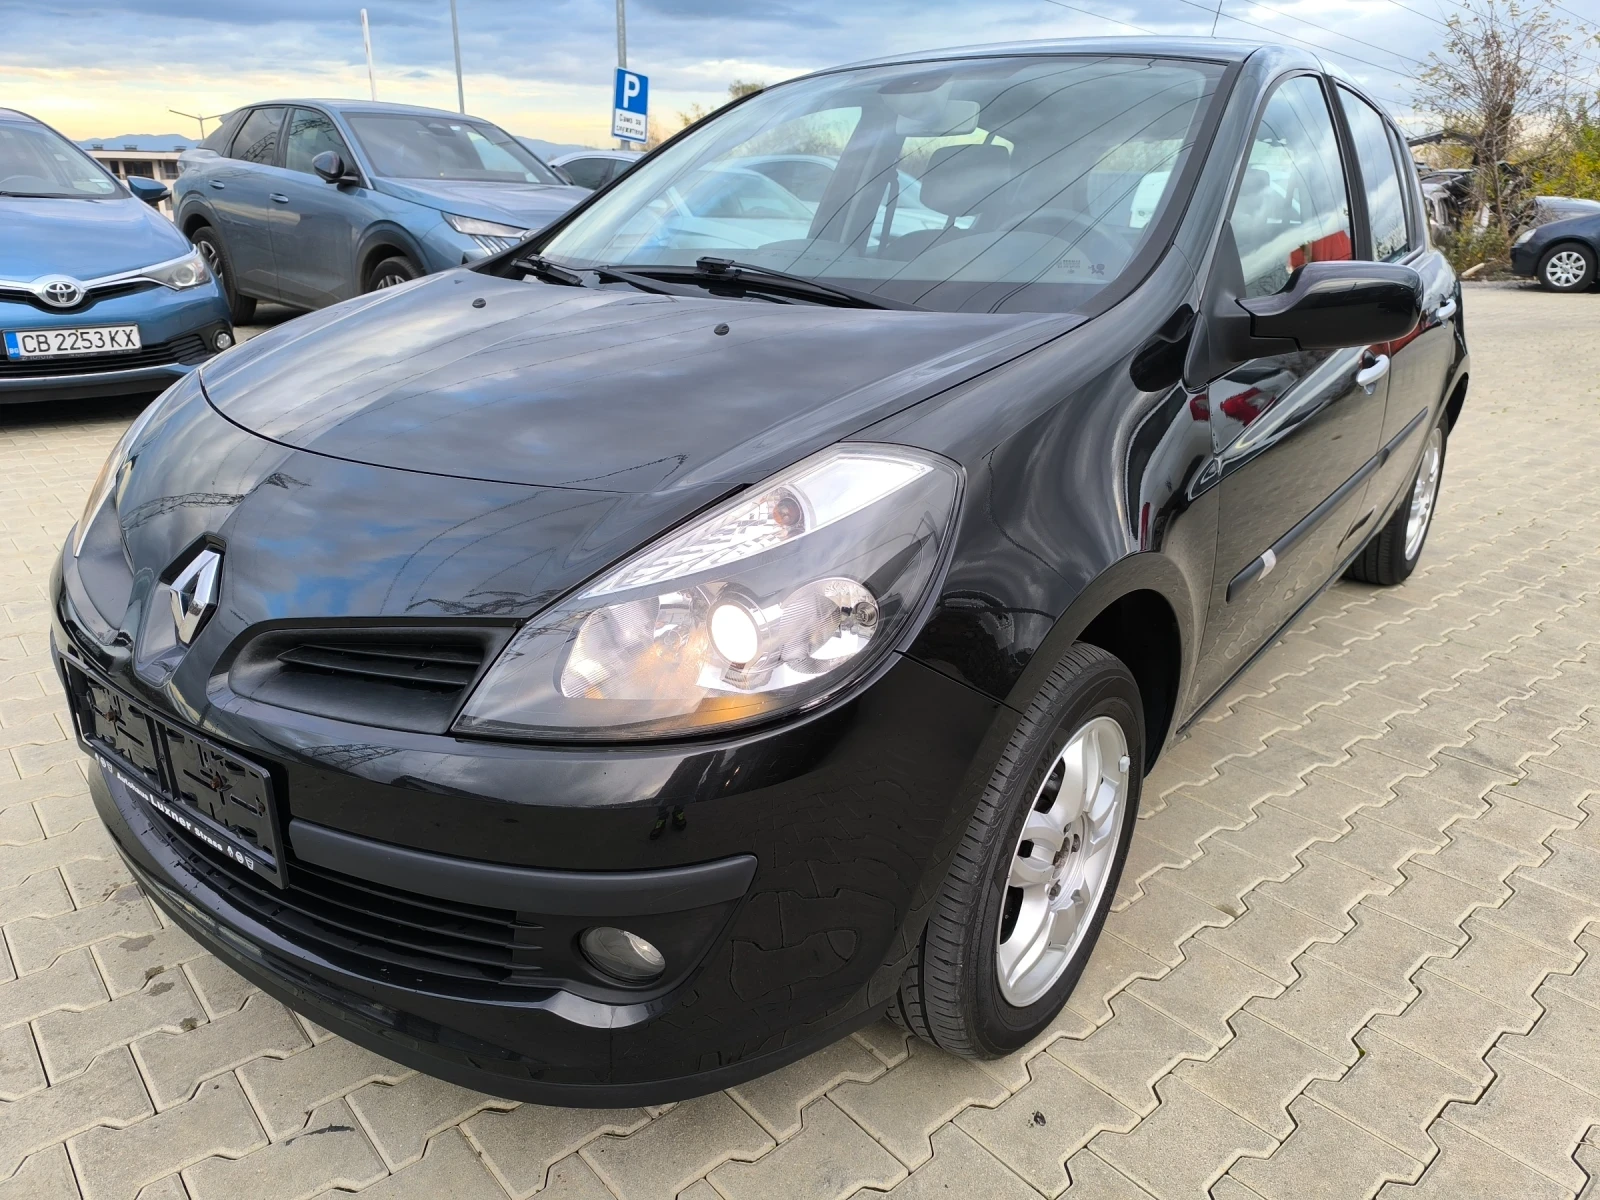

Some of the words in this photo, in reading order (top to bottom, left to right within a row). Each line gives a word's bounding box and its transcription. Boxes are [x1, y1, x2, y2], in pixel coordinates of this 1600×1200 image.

[622, 73, 641, 108] P
[21, 334, 51, 354] CB
[54, 331, 106, 352] 2253
[109, 329, 136, 348] KX
[116, 772, 149, 801] Autohaus
[149, 793, 192, 832] Luxner
[194, 826, 223, 851] Strass
[1007, 740, 1059, 842] YOKOHAMA
